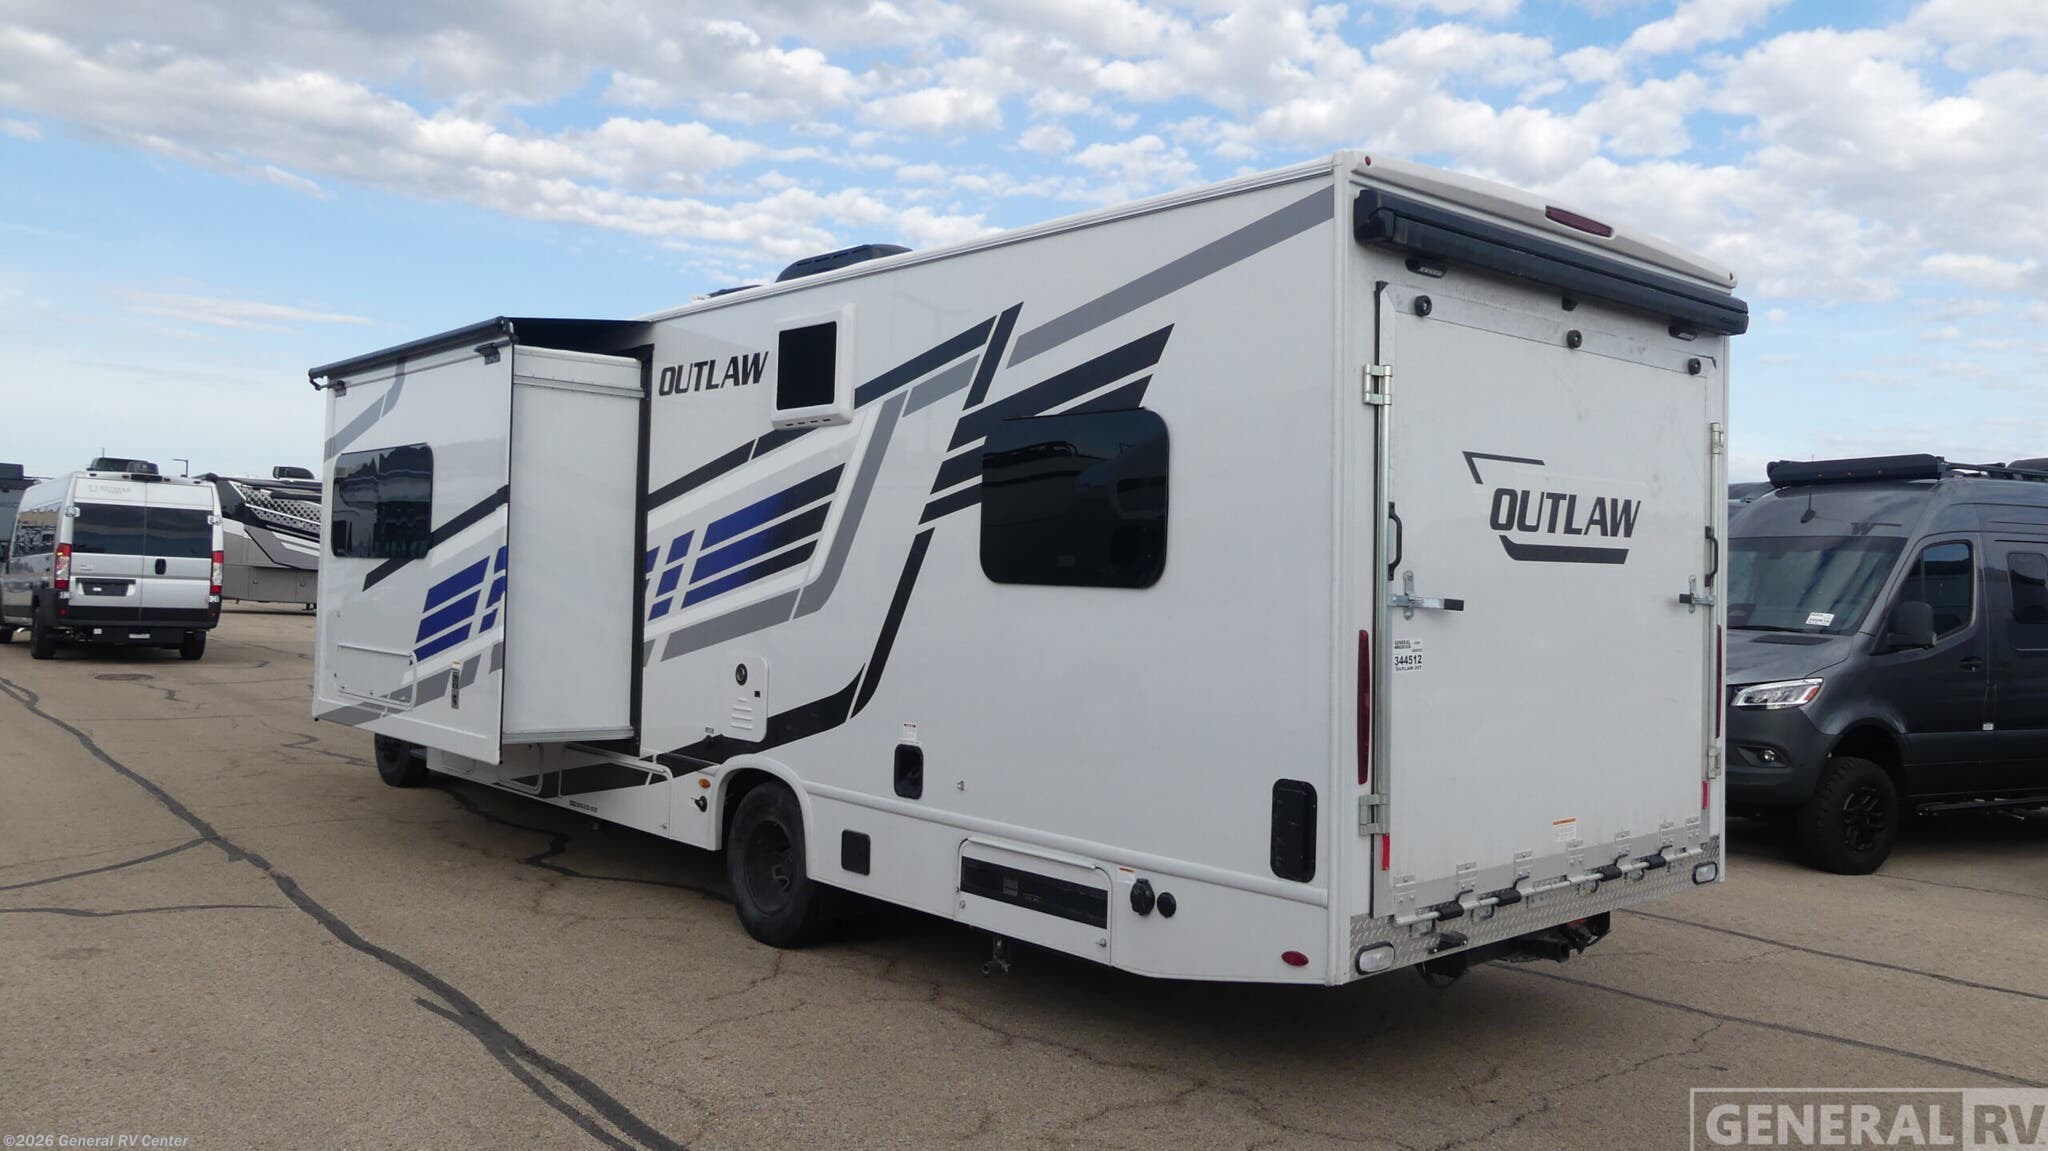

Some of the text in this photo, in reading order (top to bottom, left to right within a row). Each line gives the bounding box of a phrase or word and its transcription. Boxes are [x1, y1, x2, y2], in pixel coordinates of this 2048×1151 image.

[658, 351, 769, 397] OUTLAW
[1489, 487, 1642, 538] OUTLAW
[1394, 654, 1422, 666] 344512
